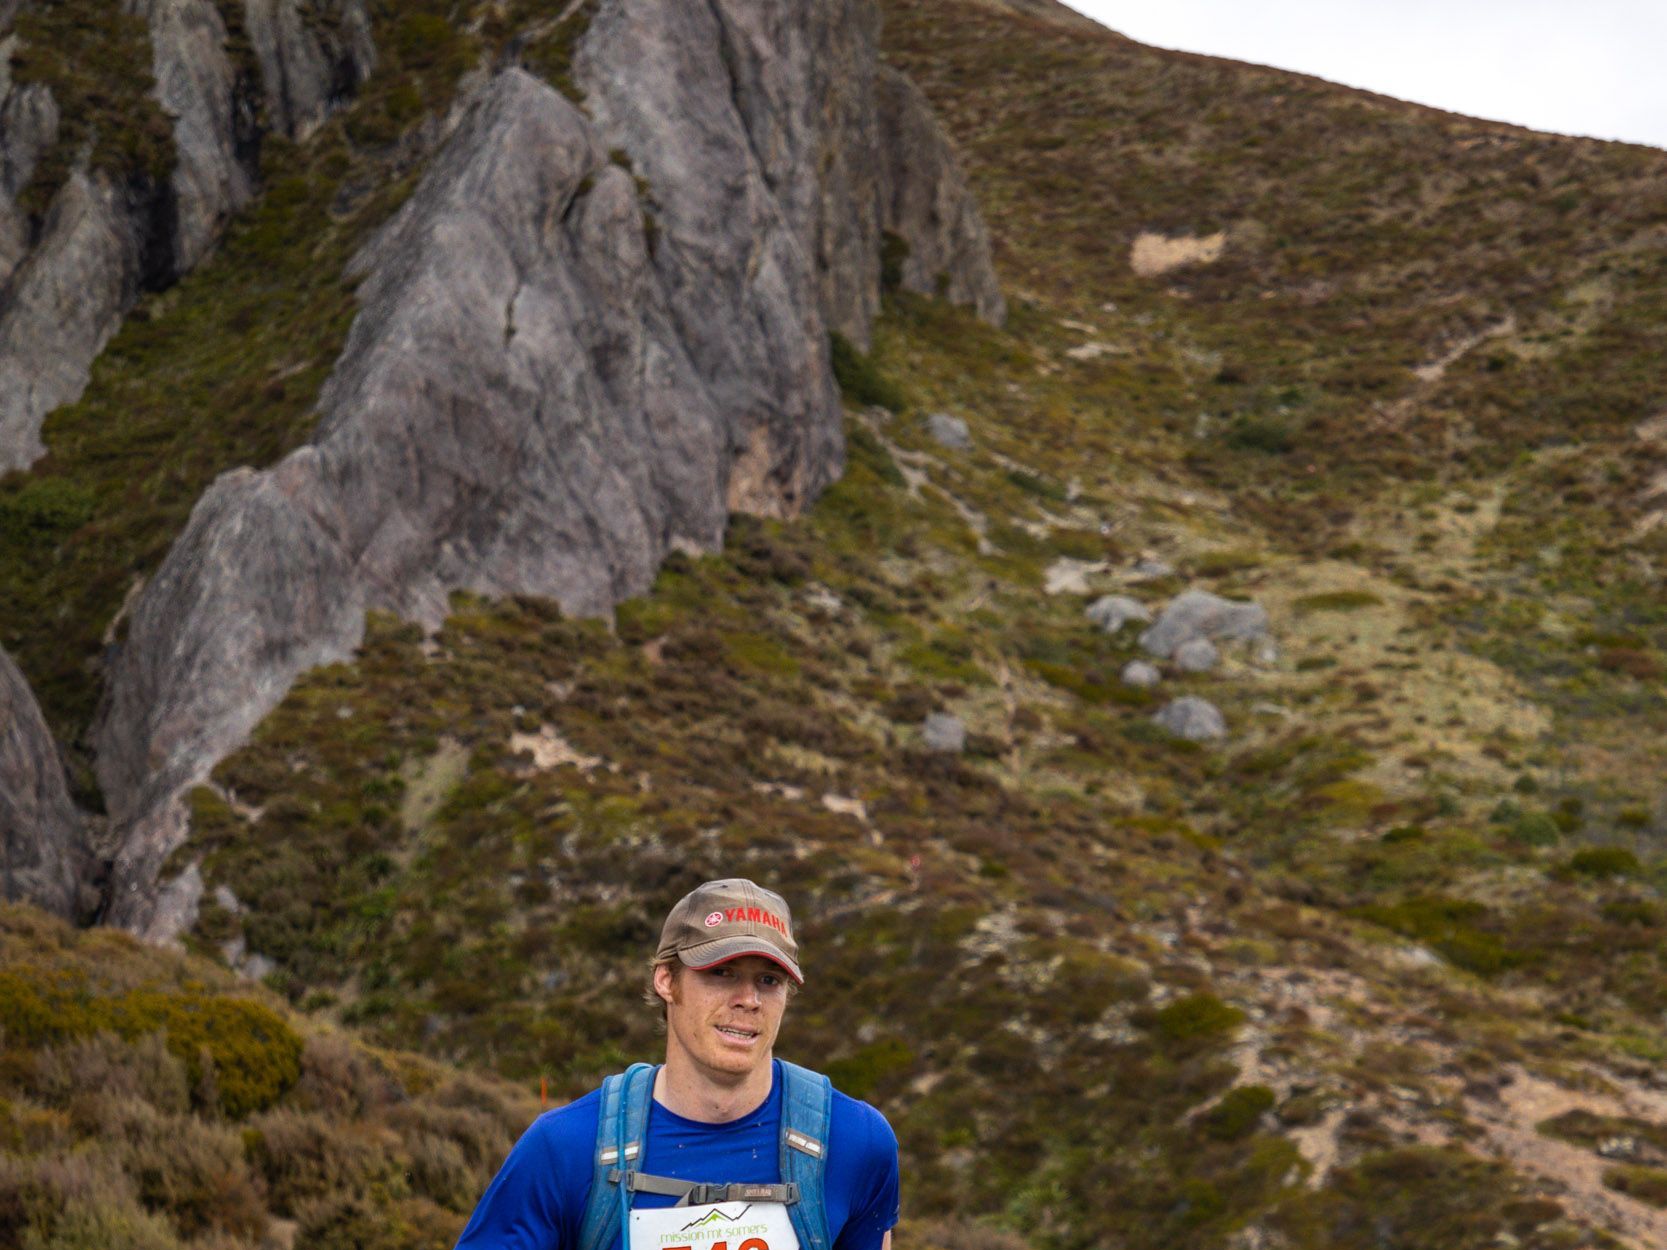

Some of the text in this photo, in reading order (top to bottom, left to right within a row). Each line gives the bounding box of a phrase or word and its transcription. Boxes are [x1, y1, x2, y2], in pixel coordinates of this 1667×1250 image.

[725, 907, 788, 937] YAMAHA
[660, 1223, 768, 1243] mission mt somers
